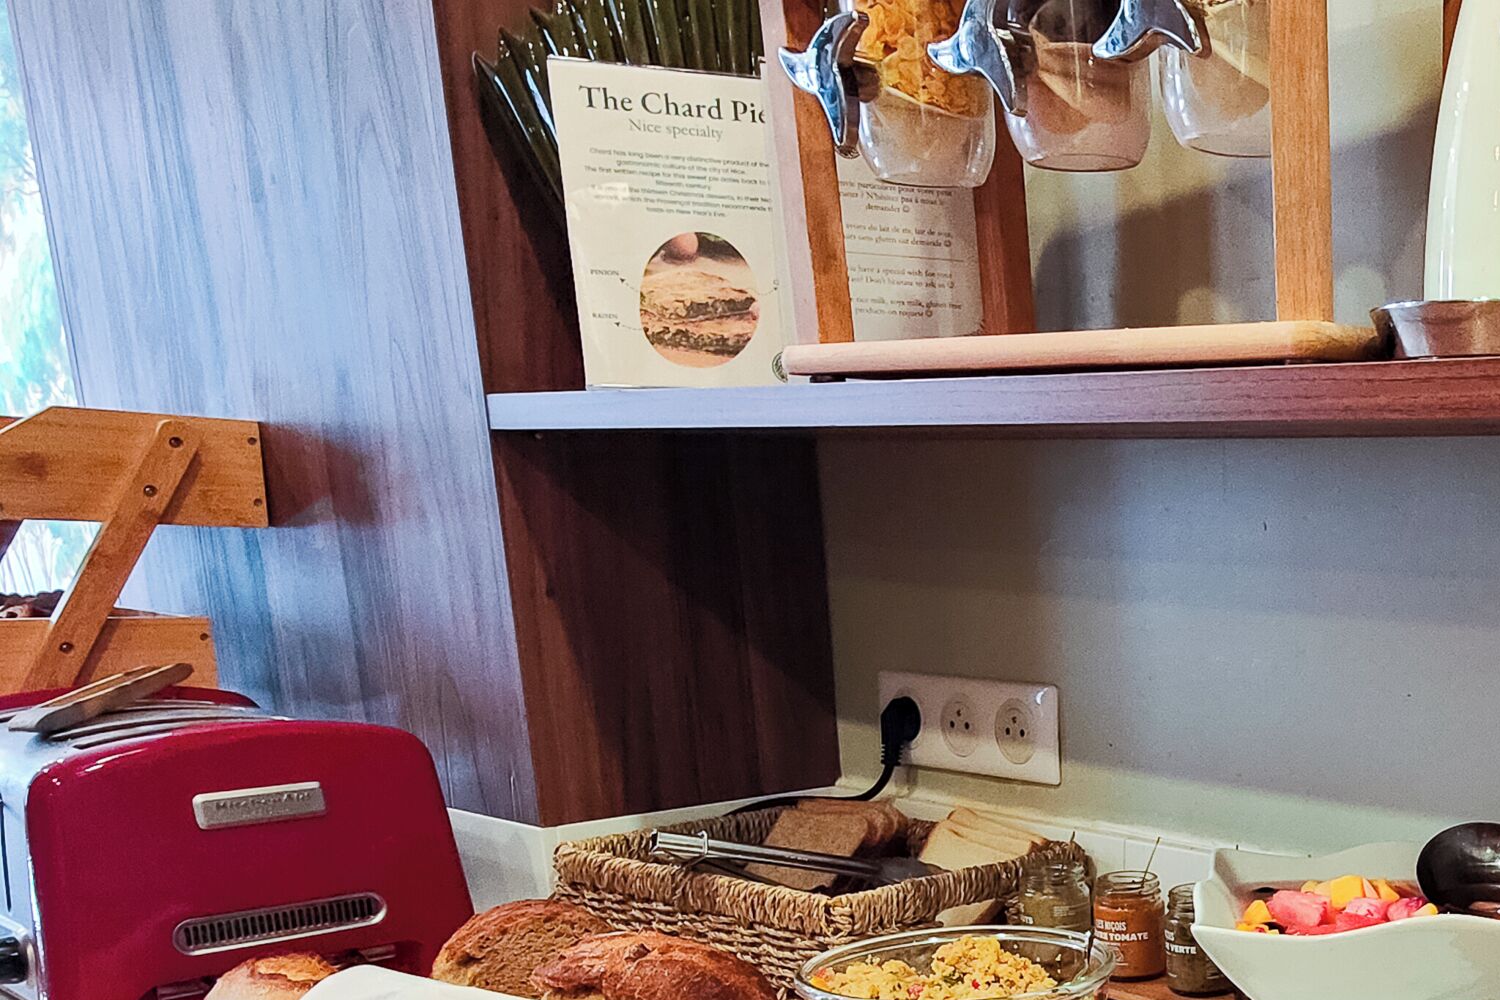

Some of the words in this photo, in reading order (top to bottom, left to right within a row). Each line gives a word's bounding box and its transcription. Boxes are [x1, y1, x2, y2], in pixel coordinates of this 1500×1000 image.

[579, 85, 633, 112] The
[641, 92, 723, 120] Chard
[629, 119, 661, 134] Nice
[666, 121, 723, 142] specialty
[628, 151, 644, 159] long
[900, 196, 913, 204] pas
[1109, 932, 1149, 942] TOMATE
[1170, 943, 1197, 955] VERTE
